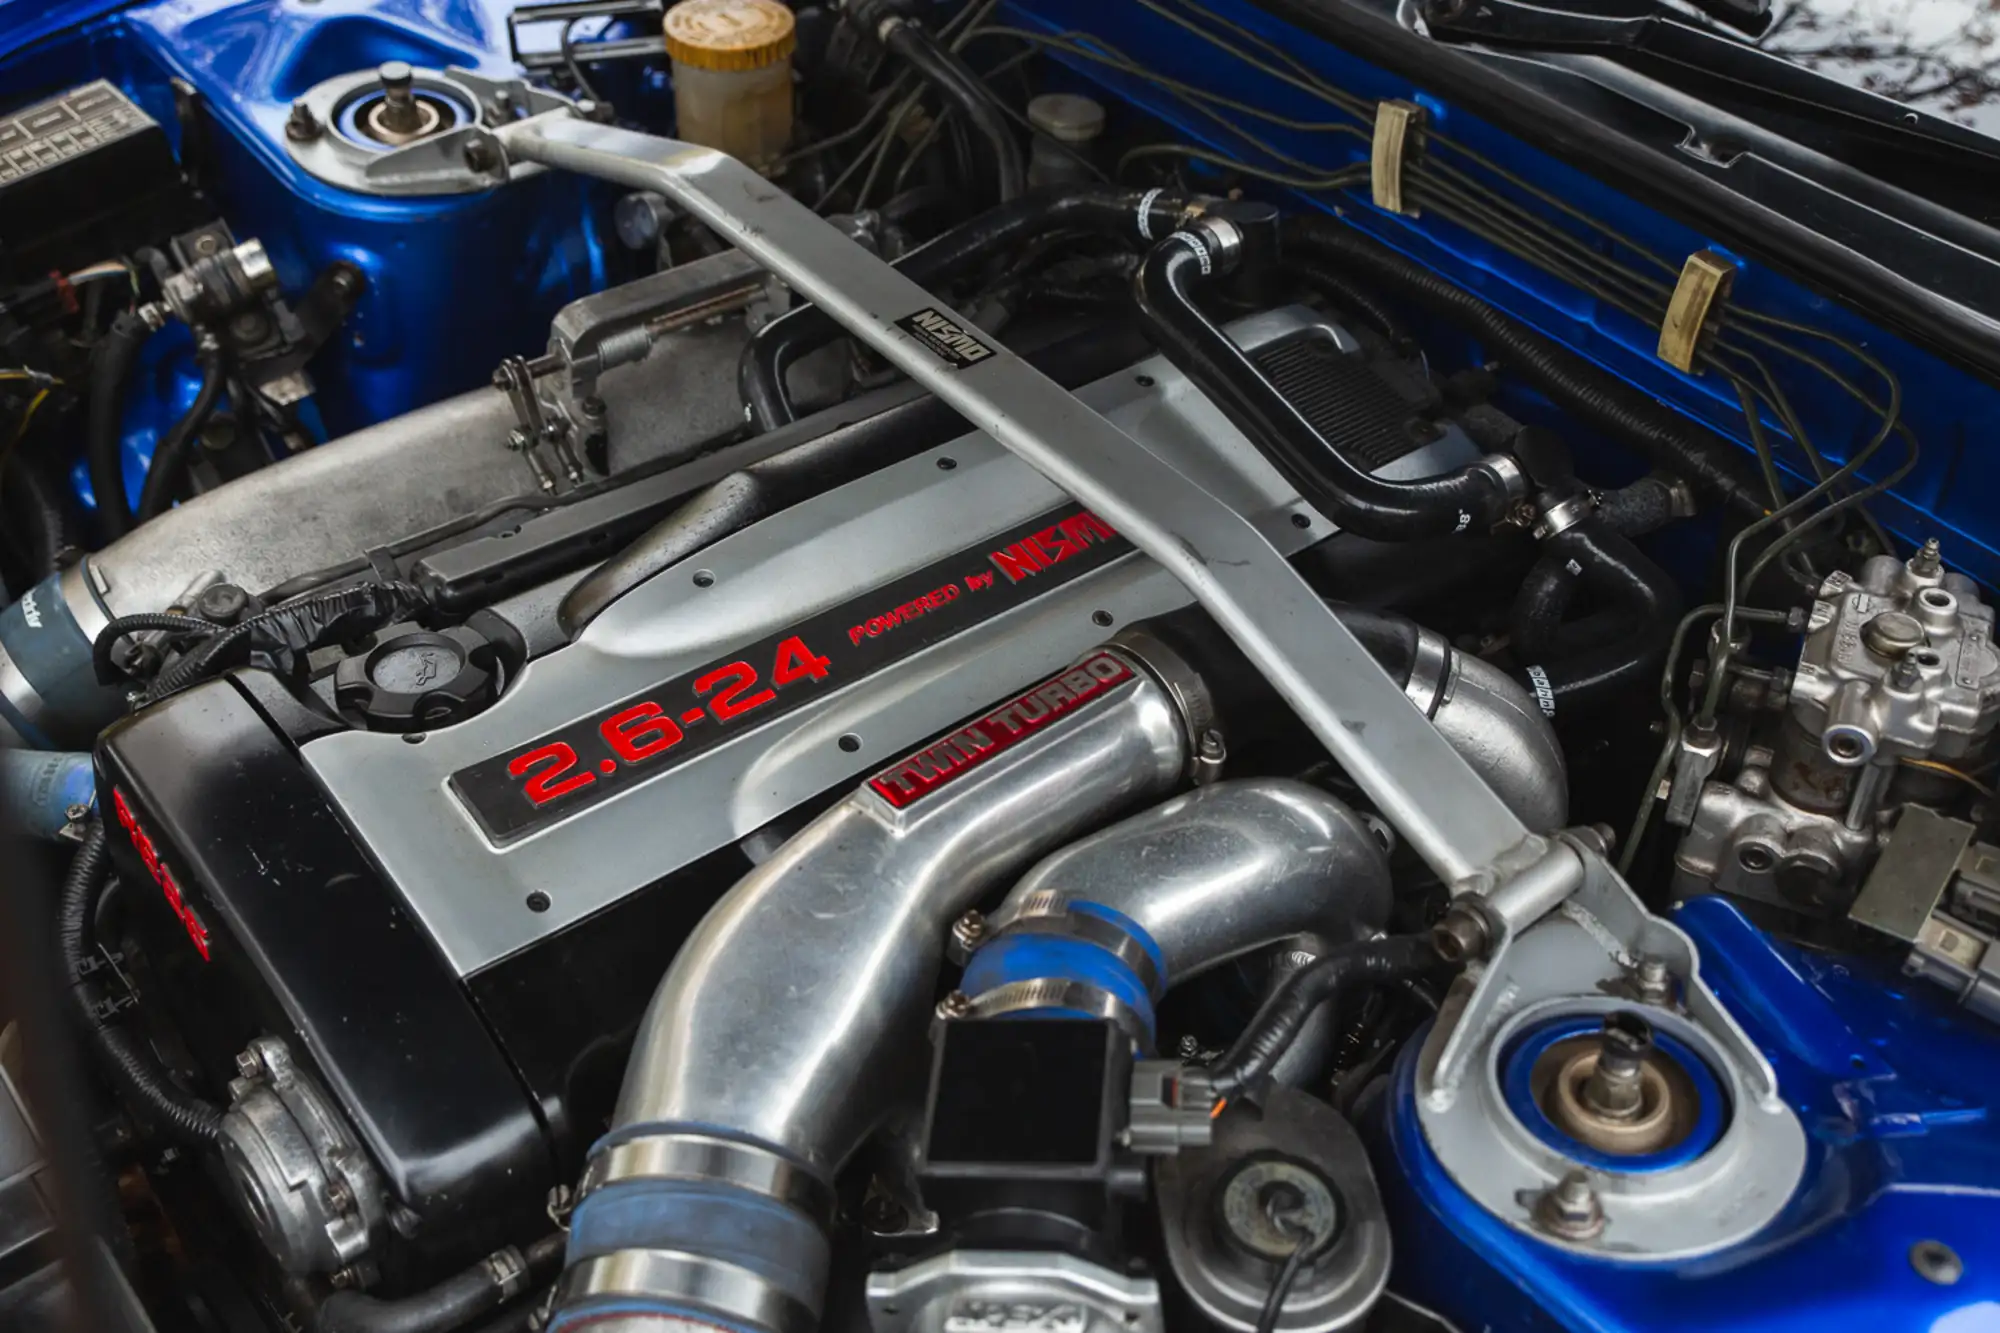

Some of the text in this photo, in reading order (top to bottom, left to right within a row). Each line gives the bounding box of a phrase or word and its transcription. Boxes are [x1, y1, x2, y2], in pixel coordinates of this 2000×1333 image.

[911, 309, 991, 362] NISMO
[507, 508, 1117, 809] 2.6-24 POWERED by NISM
[879, 655, 1123, 793] TWIN TURBO
